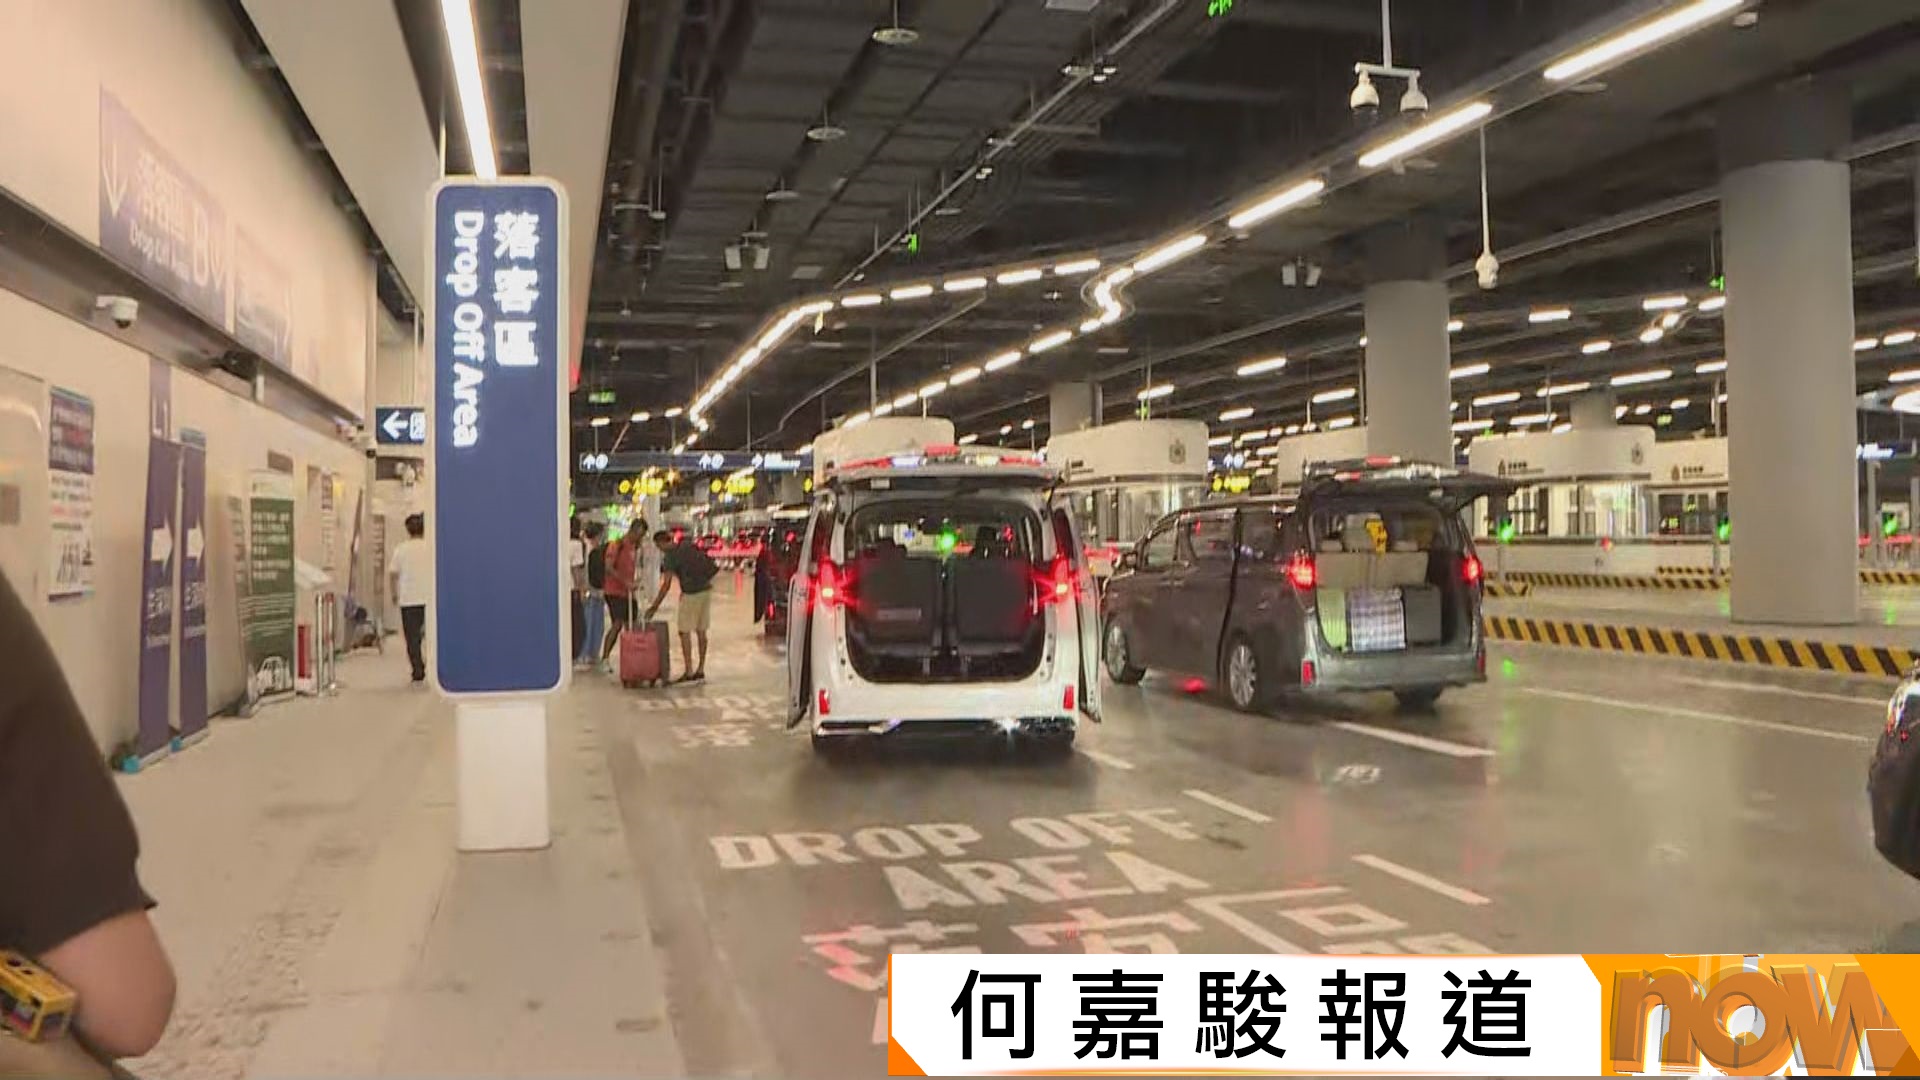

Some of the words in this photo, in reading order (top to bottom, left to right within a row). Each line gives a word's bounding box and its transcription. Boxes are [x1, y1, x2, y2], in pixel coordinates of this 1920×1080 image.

[446, 210, 485, 298] Drop
[493, 211, 540, 367] 落客區
[453, 302, 486, 362] Off
[453, 363, 485, 448] Area
[709, 823, 982, 869] DROP
[1010, 807, 1198, 849] OFF
[882, 851, 1210, 910] AREA
